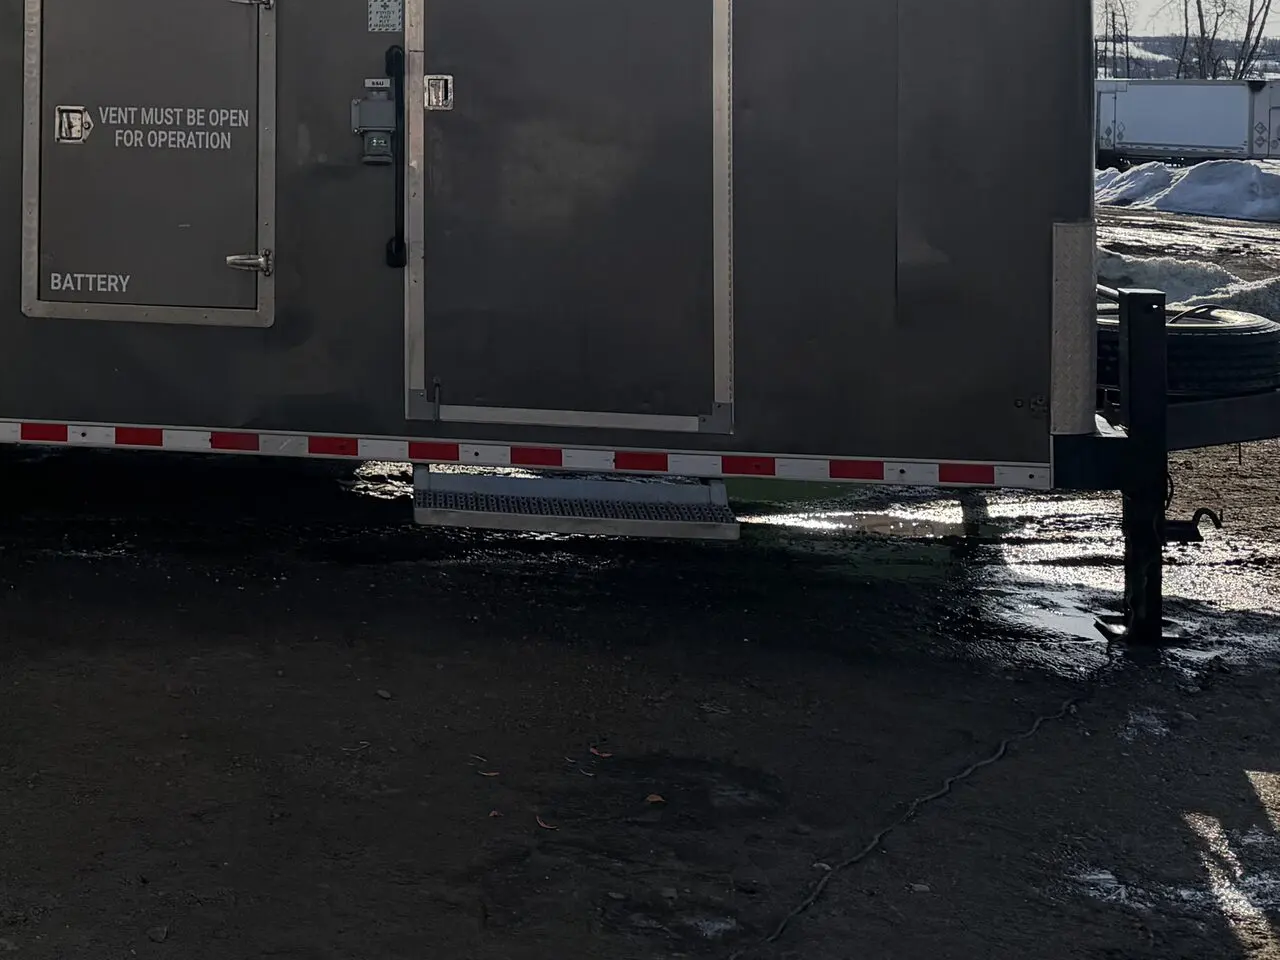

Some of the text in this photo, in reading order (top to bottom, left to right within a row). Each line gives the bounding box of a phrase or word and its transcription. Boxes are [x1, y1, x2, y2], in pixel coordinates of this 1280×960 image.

[98, 106, 249, 128] VENT MUST BE OPEN
[114, 129, 232, 150] FOR OPERATION
[50, 272, 131, 294] BATTERY
